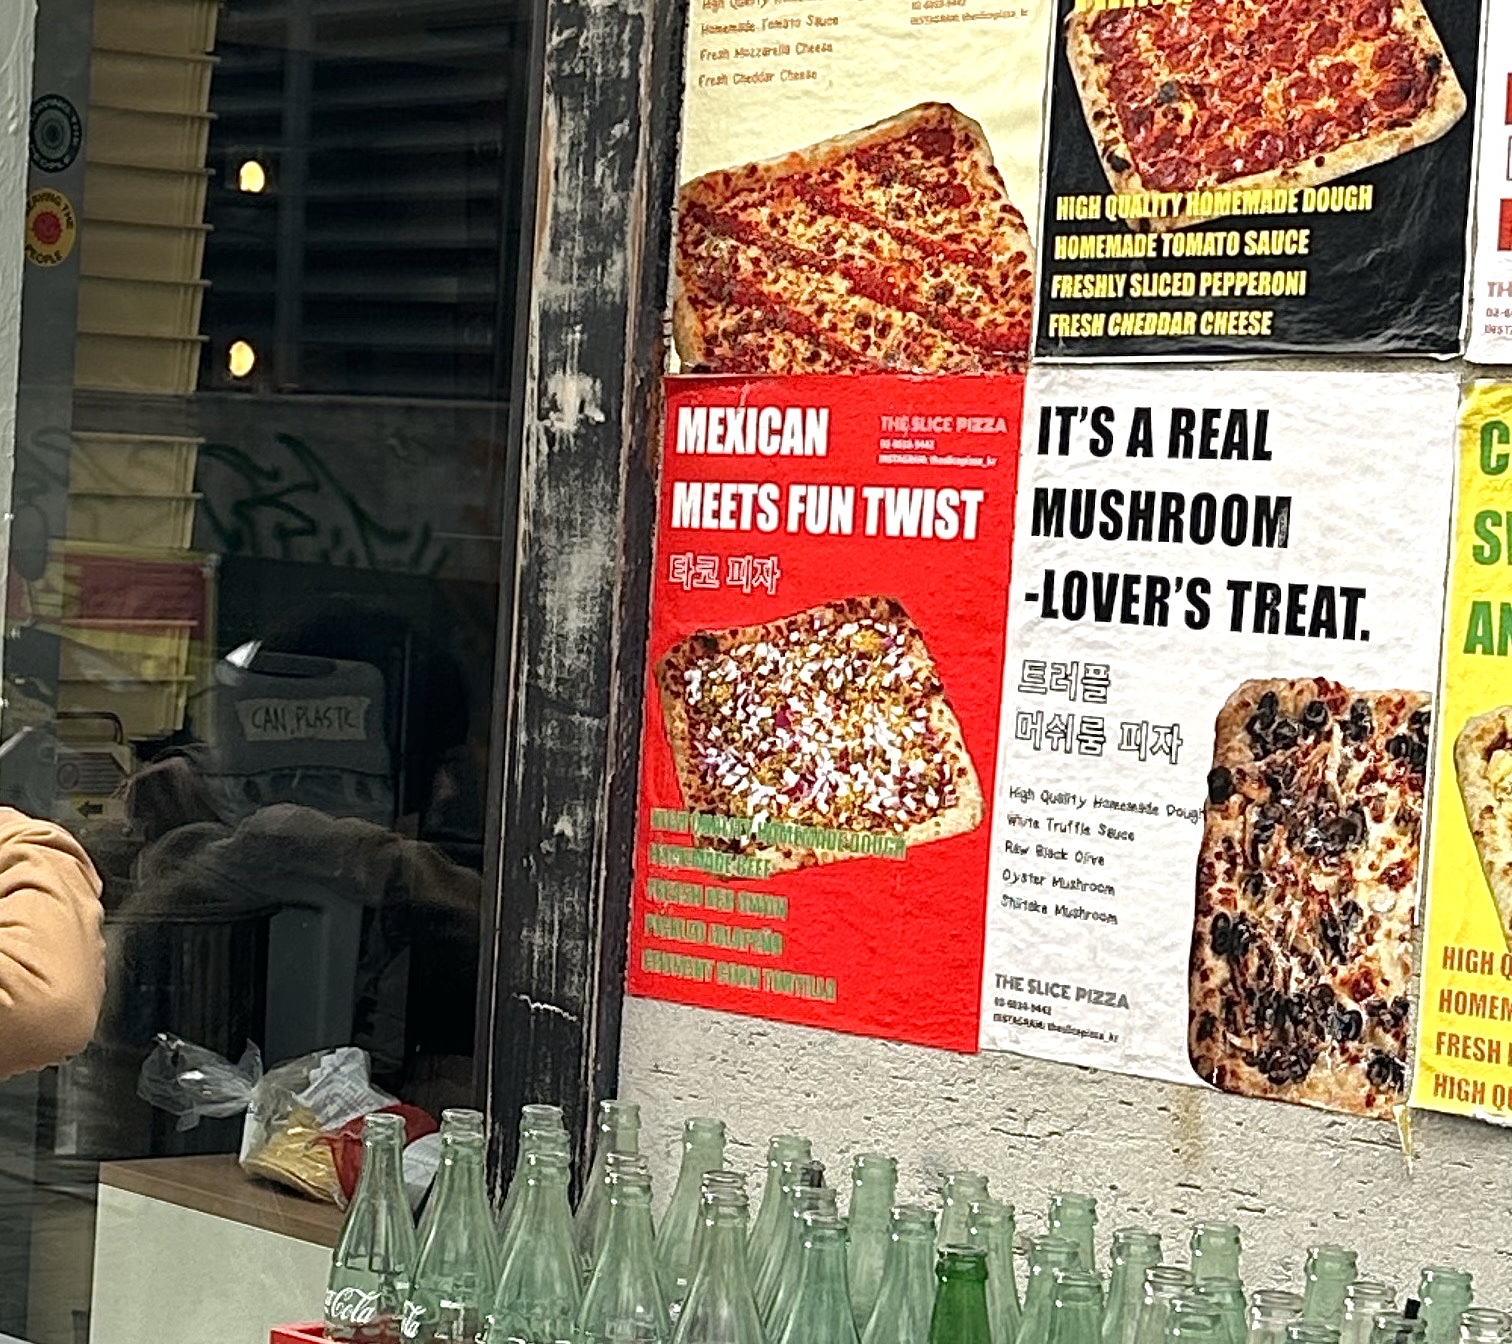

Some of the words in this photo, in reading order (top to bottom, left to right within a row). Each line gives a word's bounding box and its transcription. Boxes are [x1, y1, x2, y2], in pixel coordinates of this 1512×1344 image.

[1057, 194, 1101, 221] HIGH
[1104, 191, 1182, 220] QUALITY
[1185, 188, 1299, 217] HOMEMADE
[1301, 185, 1374, 213] DOUGH
[1054, 233, 1158, 260] HOMEMADE
[1161, 231, 1240, 258] TOMATO
[1243, 228, 1311, 256] SAUCE
[1051, 272, 1128, 300] FRESHLY
[1129, 271, 1196, 298] SLICED
[1199, 270, 1308, 297] PEPPERONI
[1048, 311, 1105, 338] FRESH
[1108, 311, 1196, 337] CHEDDAR
[1200, 309, 1275, 336] CHEESE
[676, 406, 829, 456] MEXICAN
[881, 416, 909, 433] THE
[911, 416, 953, 433] SLICE
[955, 416, 1008, 433] PIZZA
[1038, 406, 1113, 456] IT'S
[1126, 407, 1154, 458] A
[1168, 408, 1273, 461] REAL
[671, 482, 780, 533] MEETS
[787, 483, 855, 536] FUN
[862, 486, 984, 541] TWIST
[1031, 487, 1291, 549] MUSHROOM
[669, 553, 720, 592] 타코
[726, 556, 781, 595] 피자
[1025, 569, 1211, 630] -LOVER'S
[1227, 580, 1370, 641] TREAT.
[1018, 659, 1111, 704] 트러플
[1015, 710, 1106, 756] 머쉬룸
[1118, 720, 1183, 765] 피자
[1046, 817, 1091, 836] Truffle
[1098, 823, 1135, 841] Sauce
[1002, 868, 1047, 886] Oyster
[1052, 876, 1115, 896] Mushroom
[1055, 904, 1118, 925] Mushroom
[1442, 946, 1493, 975] HIGH
[995, 973, 1024, 992] THE
[1027, 978, 1071, 1000] SLICE
[1075, 986, 1130, 1009] PIZZA
[1435, 1032, 1501, 1065] FRESH
[1433, 1074, 1485, 1105] HIGH
